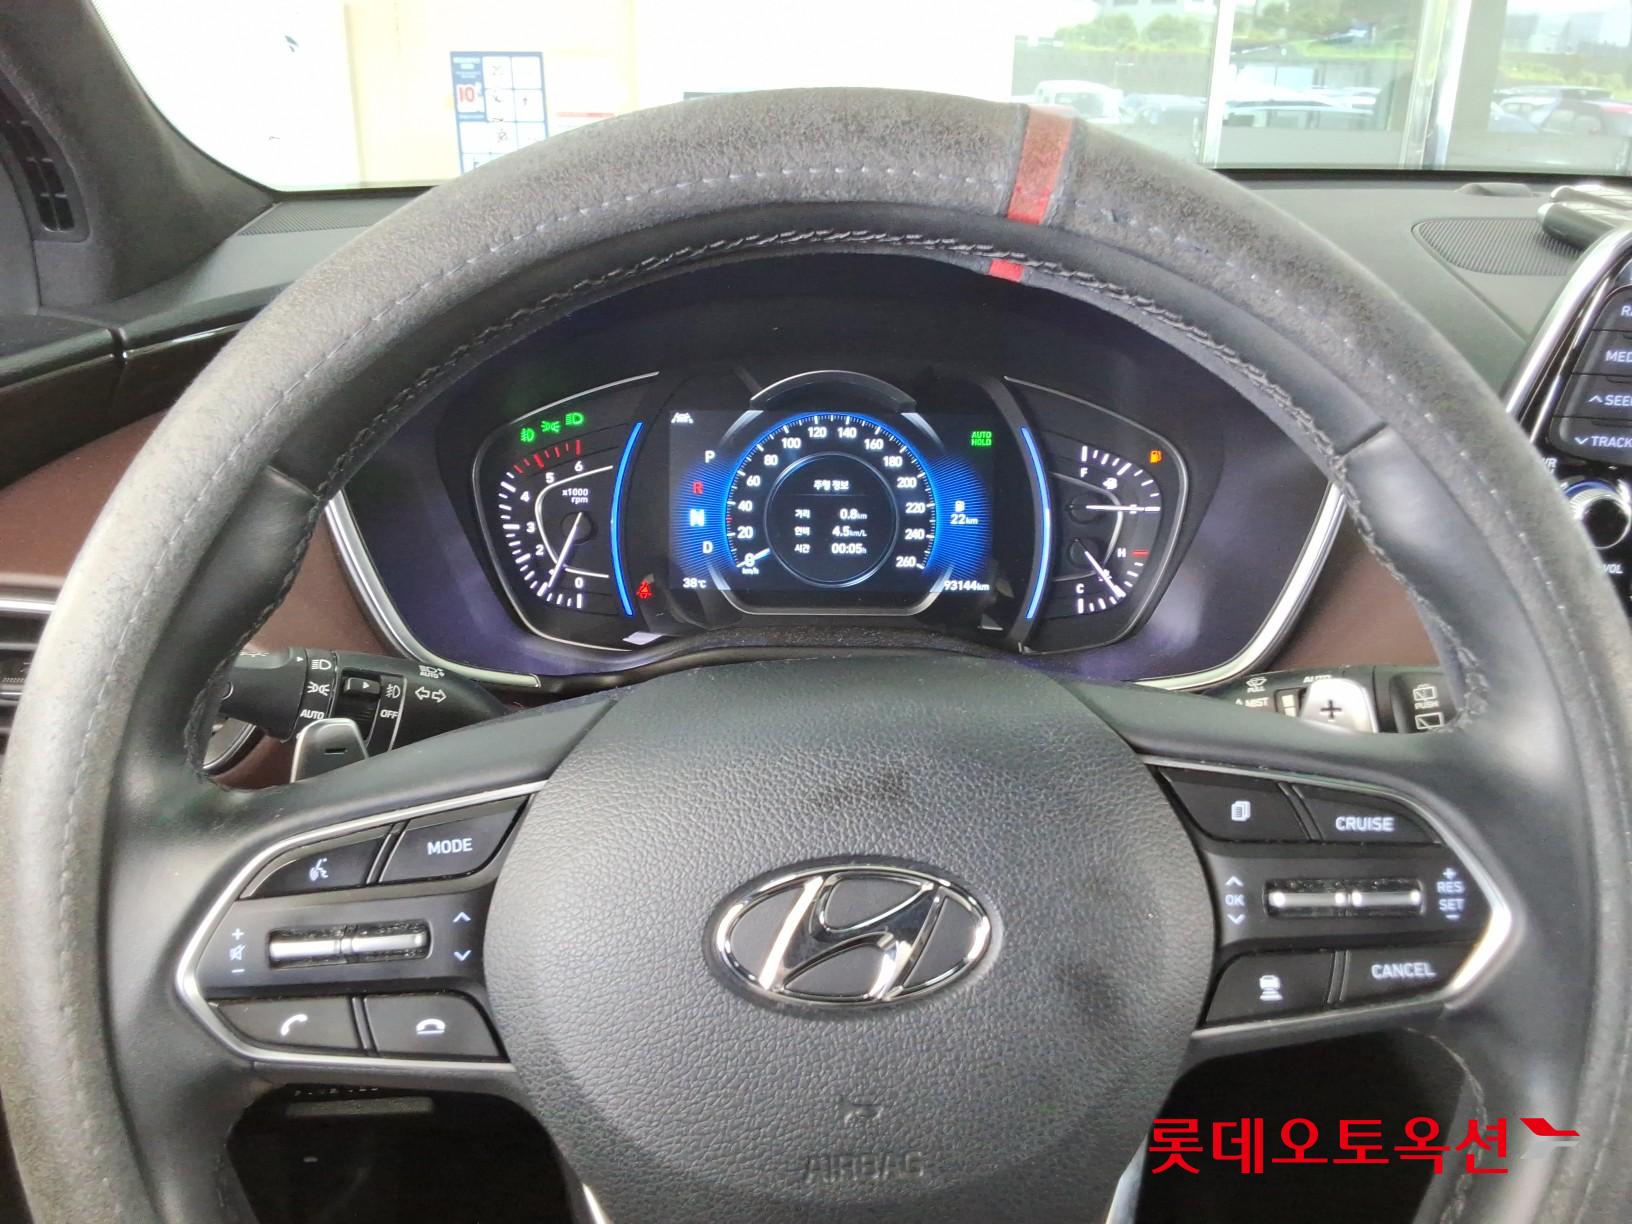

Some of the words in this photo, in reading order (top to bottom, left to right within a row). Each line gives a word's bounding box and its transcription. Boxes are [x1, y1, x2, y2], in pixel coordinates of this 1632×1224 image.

[1604, 395, 1632, 406] SEE
[808, 427, 827, 438] 120
[838, 427, 857, 438] 140
[782, 438, 801, 448] 100
[864, 439, 884, 450] 160
[705, 451, 715, 463] P
[764, 455, 778, 465] 80
[883, 456, 903, 467] 180
[574, 462, 584, 472] 6
[1080, 468, 1088, 477] F
[545, 473, 555, 483] 5
[747, 475, 761, 487] 60
[897, 477, 917, 488] 200
[832, 480, 849, 491] 정보
[520, 491, 530, 502] 4
[738, 501, 752, 512] 40
[905, 503, 925, 513] 220
[690, 509, 705, 527] N
[526, 522, 536, 533] 3
[737, 526, 753, 538] 20
[905, 529, 925, 540] 240
[535, 545, 544, 555] 2
[702, 541, 713, 553] D
[1117, 548, 1126, 557] H
[896, 556, 916, 567] 260
[575, 578, 584, 588] 0
[1076, 584, 1084, 593] C
[300, 709, 325, 720] AUTO
[380, 709, 399, 719] OFF
[1335, 817, 1395, 832] CRUISE
[427, 838, 473, 856] MODE
[1437, 881, 1463, 893] RES
[1225, 894, 1244, 906] OK
[1439, 899, 1464, 912] SET
[1371, 963, 1436, 979] CANCEL
